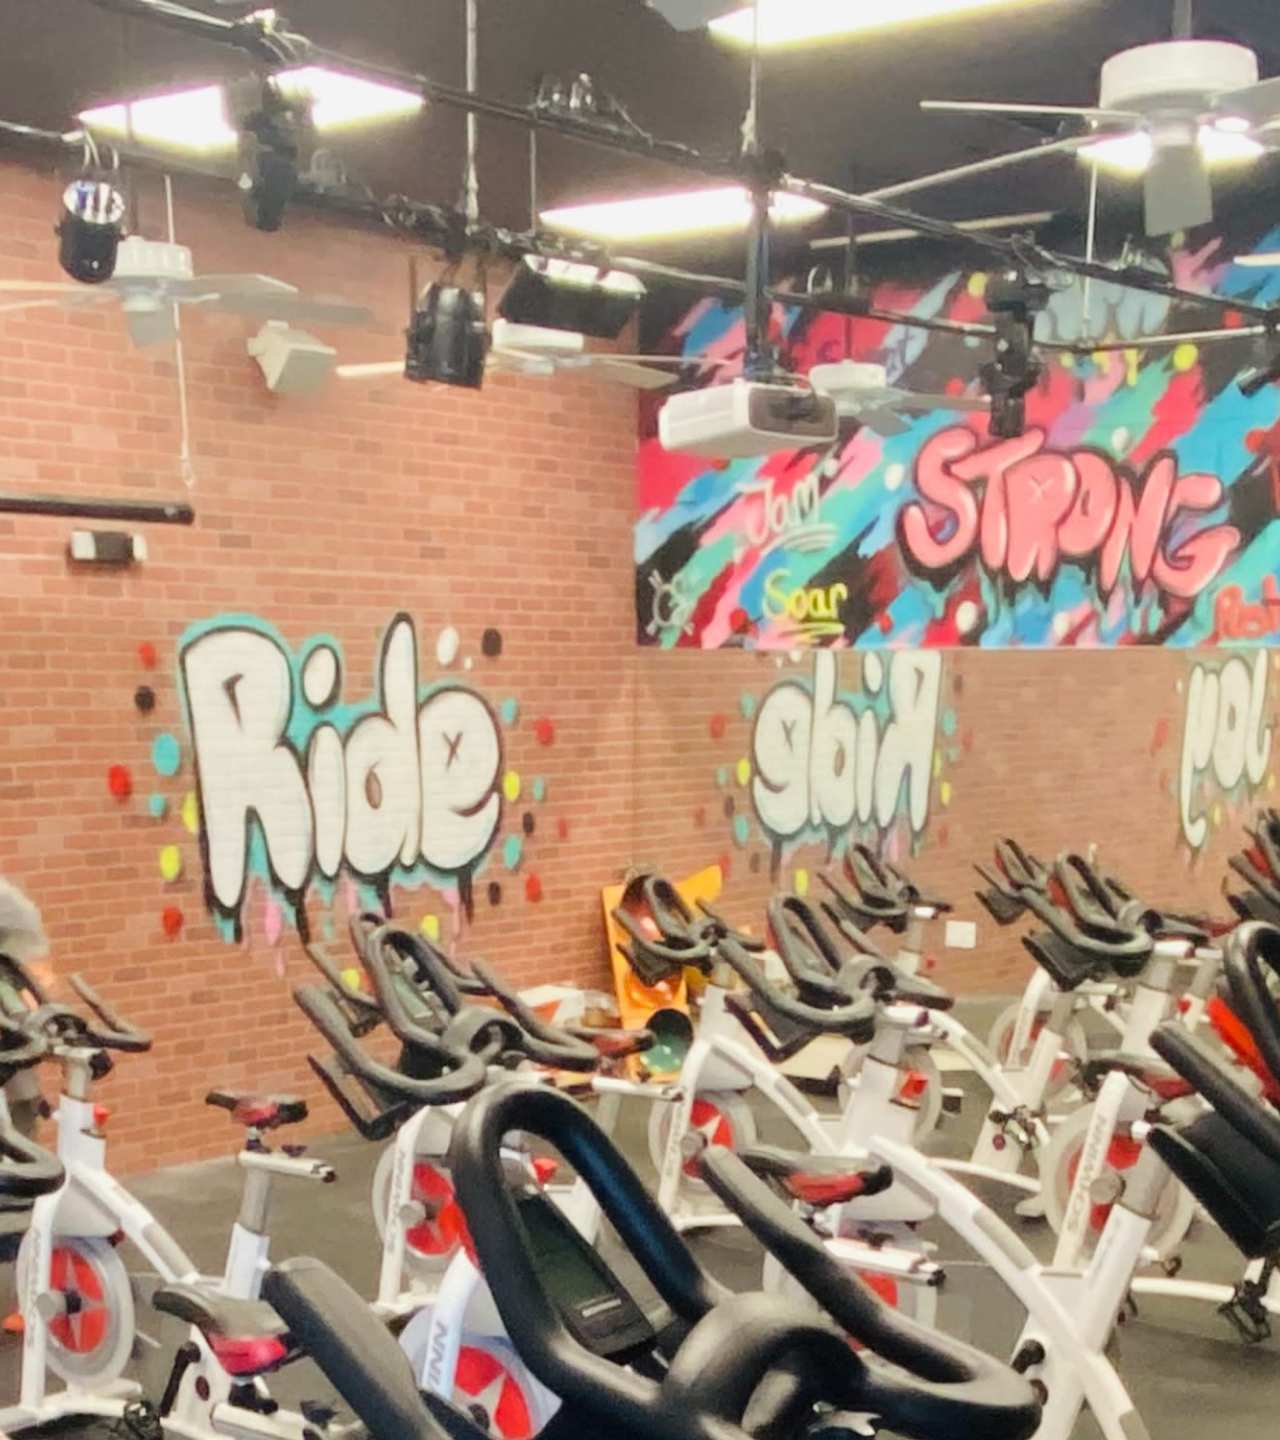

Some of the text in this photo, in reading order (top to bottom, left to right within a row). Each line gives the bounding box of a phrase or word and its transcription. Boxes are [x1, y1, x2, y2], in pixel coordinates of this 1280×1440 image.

[762, 567, 848, 621] Soar
[897, 425, 1240, 598] STRONG
[180, 611, 502, 918] Ride
